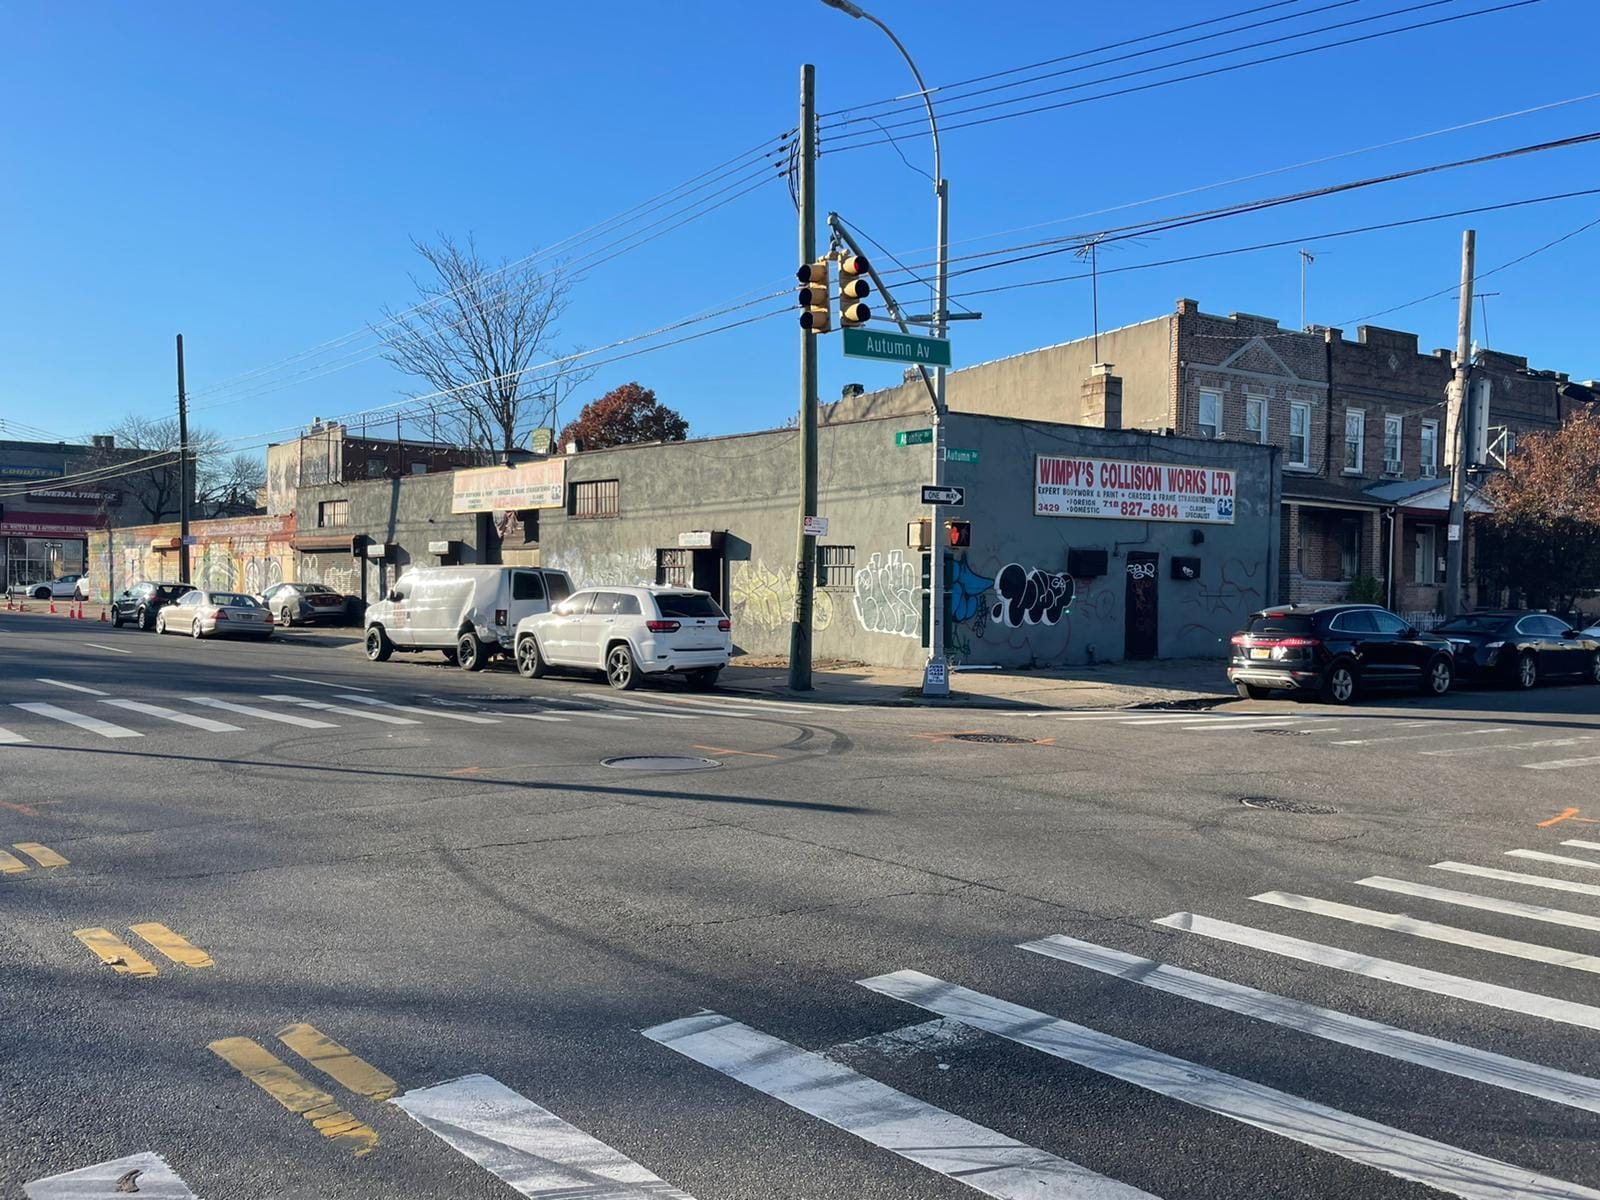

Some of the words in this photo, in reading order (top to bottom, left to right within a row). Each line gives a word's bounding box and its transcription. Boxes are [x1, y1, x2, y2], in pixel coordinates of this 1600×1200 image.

[866, 336, 912, 357] Autumn
[916, 343, 930, 358] Av
[946, 449, 970, 462] Autumn
[1039, 458, 1095, 488] WIMPY'S
[1100, 462, 1162, 492] COLLISION
[1167, 467, 1207, 495] WORKS
[1211, 471, 1233, 497] LTD.
[30, 490, 77, 498] GENERAL
[1037, 486, 1060, 495] EXPERT
[1062, 488, 1095, 497] BODYWORK
[1102, 490, 1119, 498] PAINT
[1127, 492, 1151, 500] CHASSIS
[1038, 503, 1060, 512] 3429
[1069, 506, 1100, 514] DOMESTIC
[1102, 500, 1119, 508] 718
[1120, 501, 1178, 518] 827-8914
